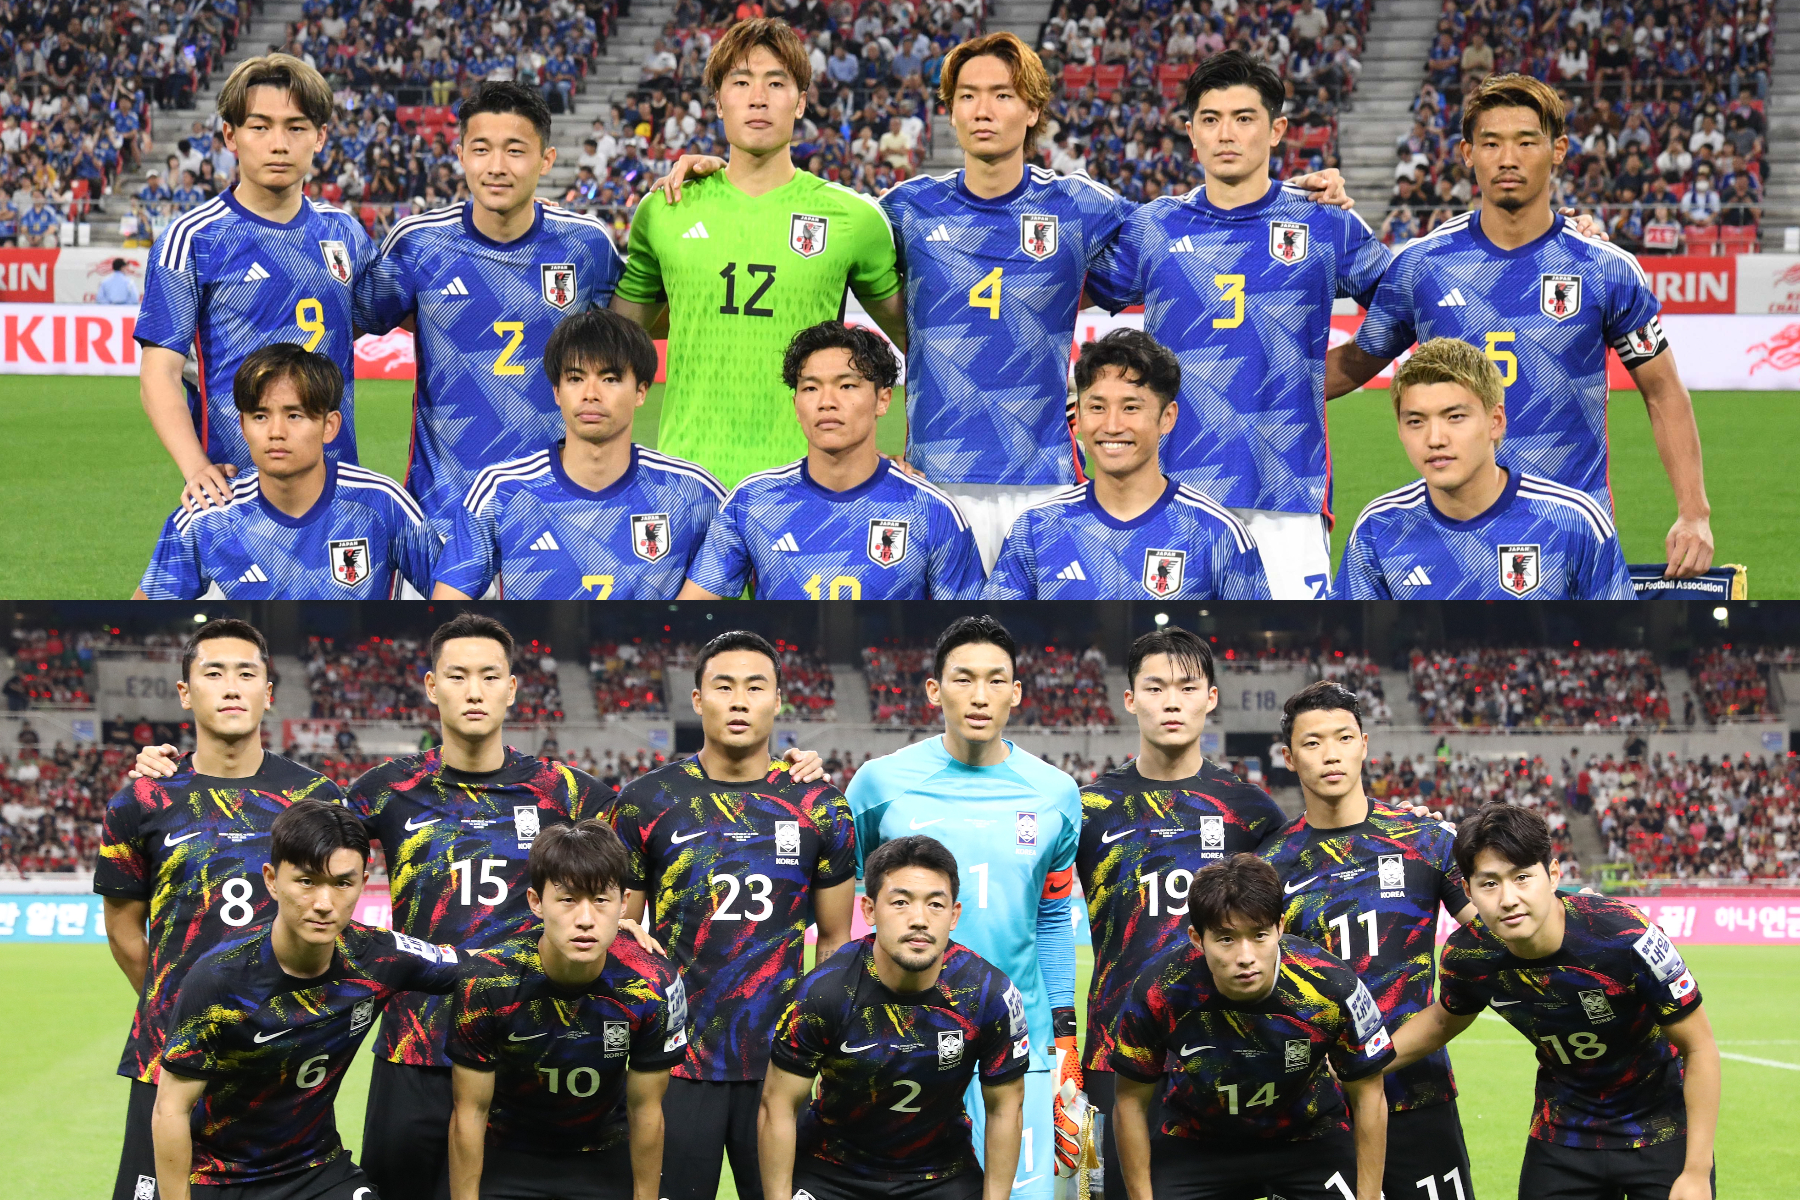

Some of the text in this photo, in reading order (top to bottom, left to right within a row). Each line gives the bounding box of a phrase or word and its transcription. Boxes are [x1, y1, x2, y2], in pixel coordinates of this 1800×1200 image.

[799, 243, 814, 252] JFA
[1032, 244, 1047, 252] JFA
[1281, 249, 1296, 258] JFA
[0, 263, 47, 291] IN
[720, 262, 776, 317] 12
[554, 293, 568, 302] JFA
[970, 268, 1002, 319] 4
[1214, 275, 1246, 328] 3
[1552, 304, 1569, 313] JFA
[296, 298, 325, 352] 9
[494, 322, 525, 375] 2
[1485, 332, 1518, 388] 5
[645, 546, 660, 555] JFA
[878, 550, 894, 559] JFA
[343, 571, 360, 580] JFA
[1154, 581, 1170, 590] JFA
[1510, 579, 1528, 587] JFA
[1644, 580, 1675, 591] Football
[1676, 581, 1724, 593] Association
[776, 857, 799, 866] KOREA
[1015, 848, 1037, 856] KOREA
[449, 859, 509, 906] 15
[709, 874, 774, 921] 23
[968, 863, 988, 908] 1
[1139, 868, 1195, 916] 19
[1380, 890, 1406, 899] KOREA
[220, 878, 254, 926] 8
[26, 902, 89, 936] 알면
[1328, 909, 1379, 960] 11
[1650, 933, 1670, 966] 내일
[1591, 1014, 1617, 1026] KOREA
[1540, 1031, 1607, 1066] 18
[296, 1054, 329, 1089] 6
[539, 1067, 601, 1098] 10
[938, 1061, 962, 1072] KOREA
[889, 1080, 921, 1112] 2
[1217, 1081, 1280, 1115] 14
[1022, 1127, 1034, 1173] 1
[1416, 1167, 1467, 1200] 11
